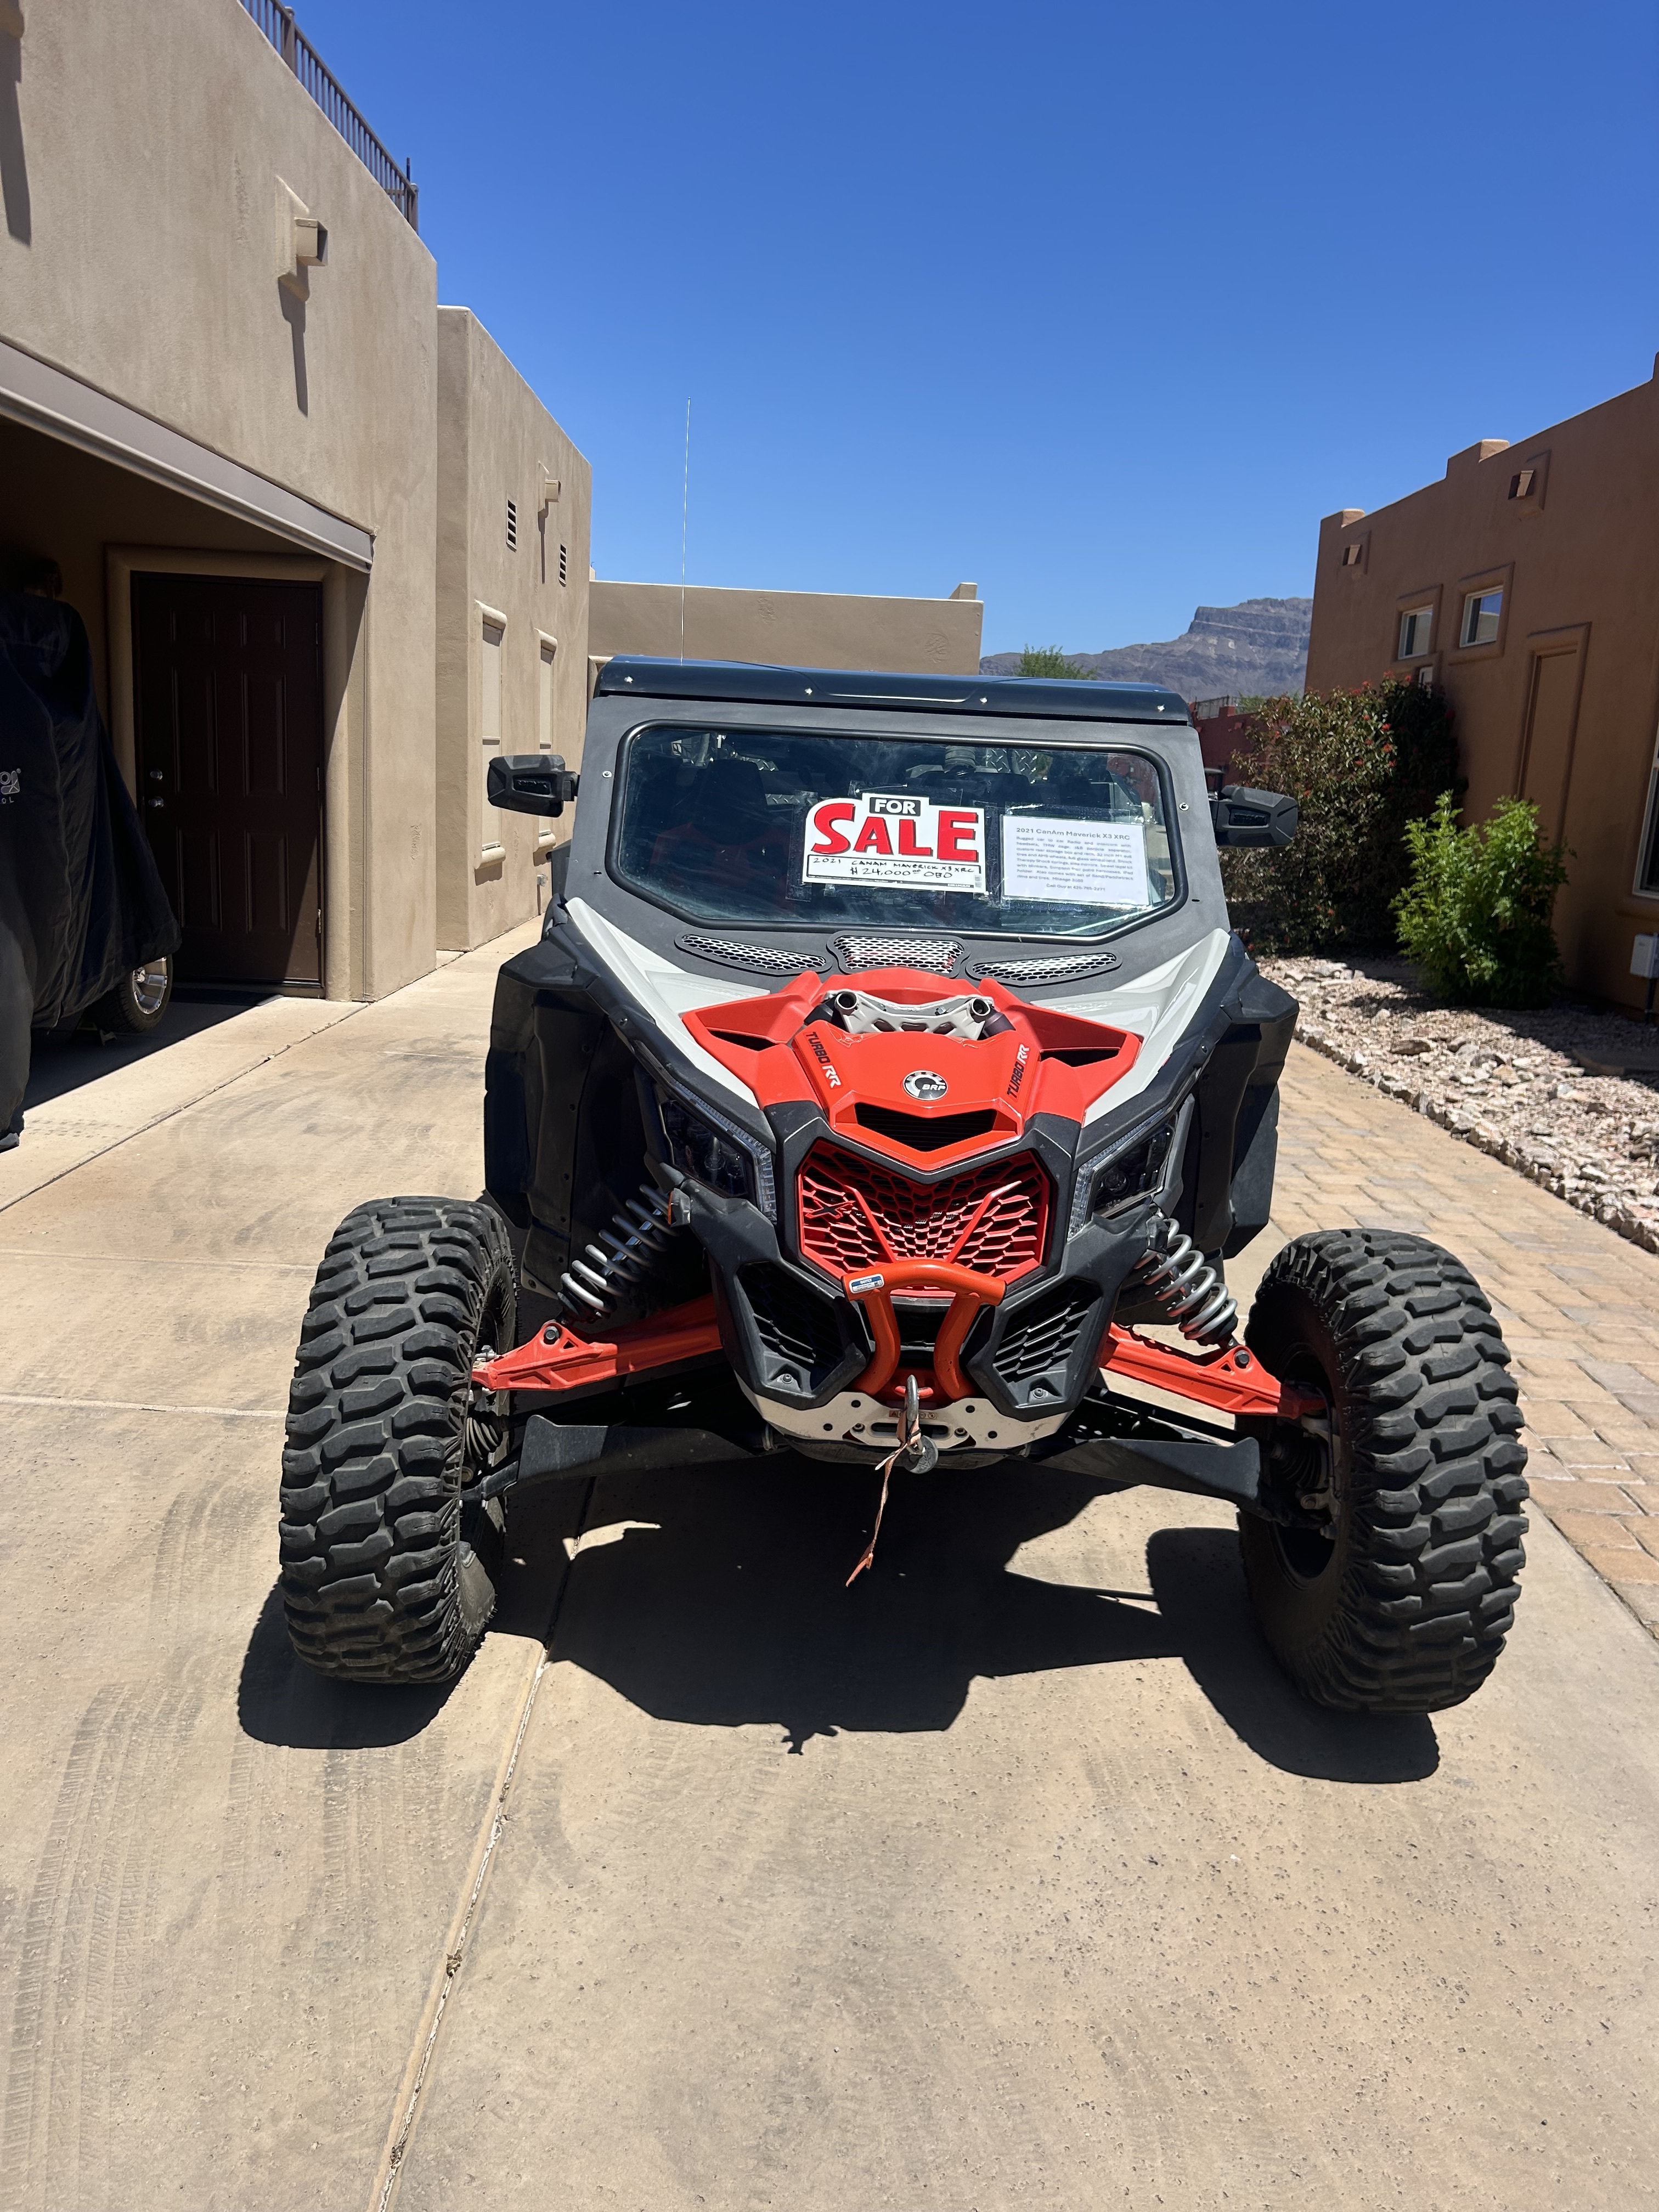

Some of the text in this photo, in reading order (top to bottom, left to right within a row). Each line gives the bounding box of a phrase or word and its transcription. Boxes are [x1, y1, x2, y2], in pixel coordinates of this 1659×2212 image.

[811, 802, 979, 862] SALE
[874, 799, 916, 815] FOR
[805, 1031, 842, 1088] TURBO RR
[1006, 1043, 1030, 1099] TURBO RR
